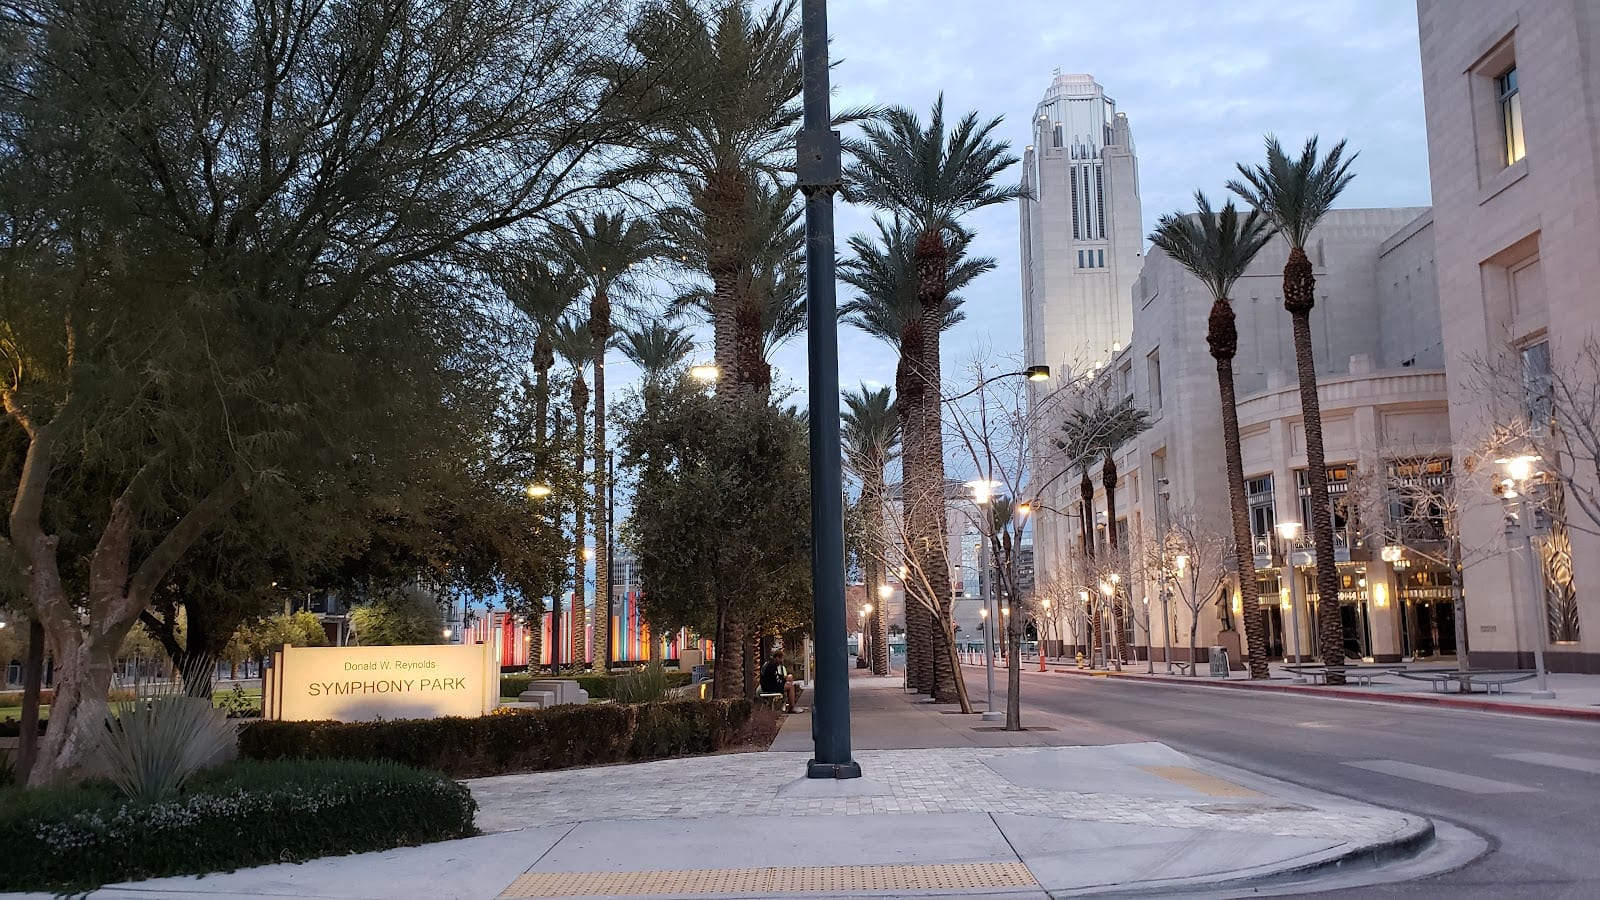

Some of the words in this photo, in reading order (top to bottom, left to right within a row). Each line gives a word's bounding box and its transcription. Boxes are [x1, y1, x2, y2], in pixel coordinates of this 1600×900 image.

[344, 661, 377, 671] Donald
[379, 661, 391, 670] W.
[395, 660, 436, 672] Reynolds
[308, 679, 415, 697] SYMPHONY
[420, 677, 466, 691] PARK
